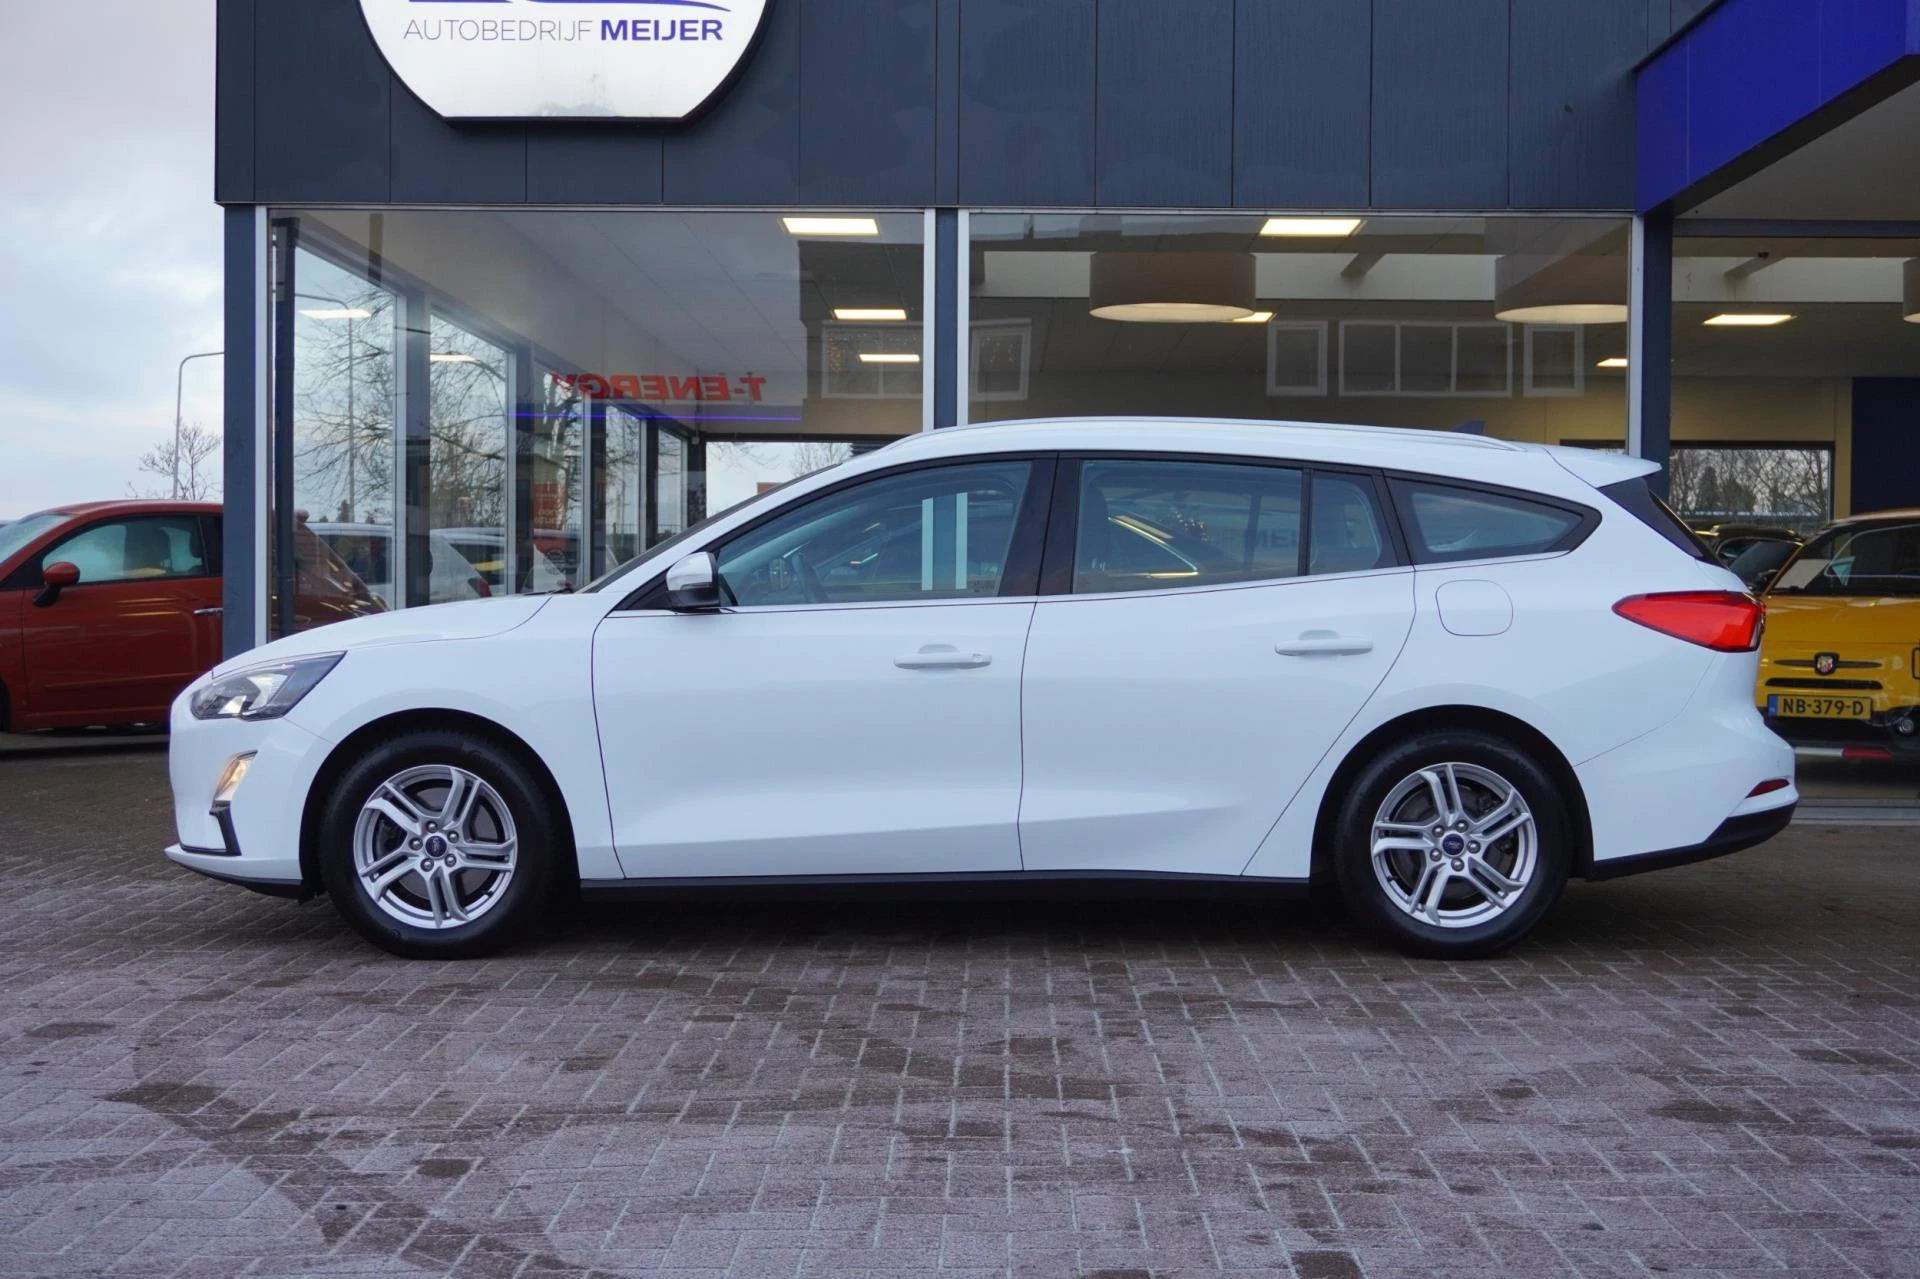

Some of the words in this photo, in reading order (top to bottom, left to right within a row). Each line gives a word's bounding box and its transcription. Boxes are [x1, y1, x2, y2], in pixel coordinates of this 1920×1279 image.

[403, 19, 593, 41] AUTOBEDRIJF
[600, 19, 723, 41] MEIJER
[1782, 698, 1864, 716] NB-379-D
